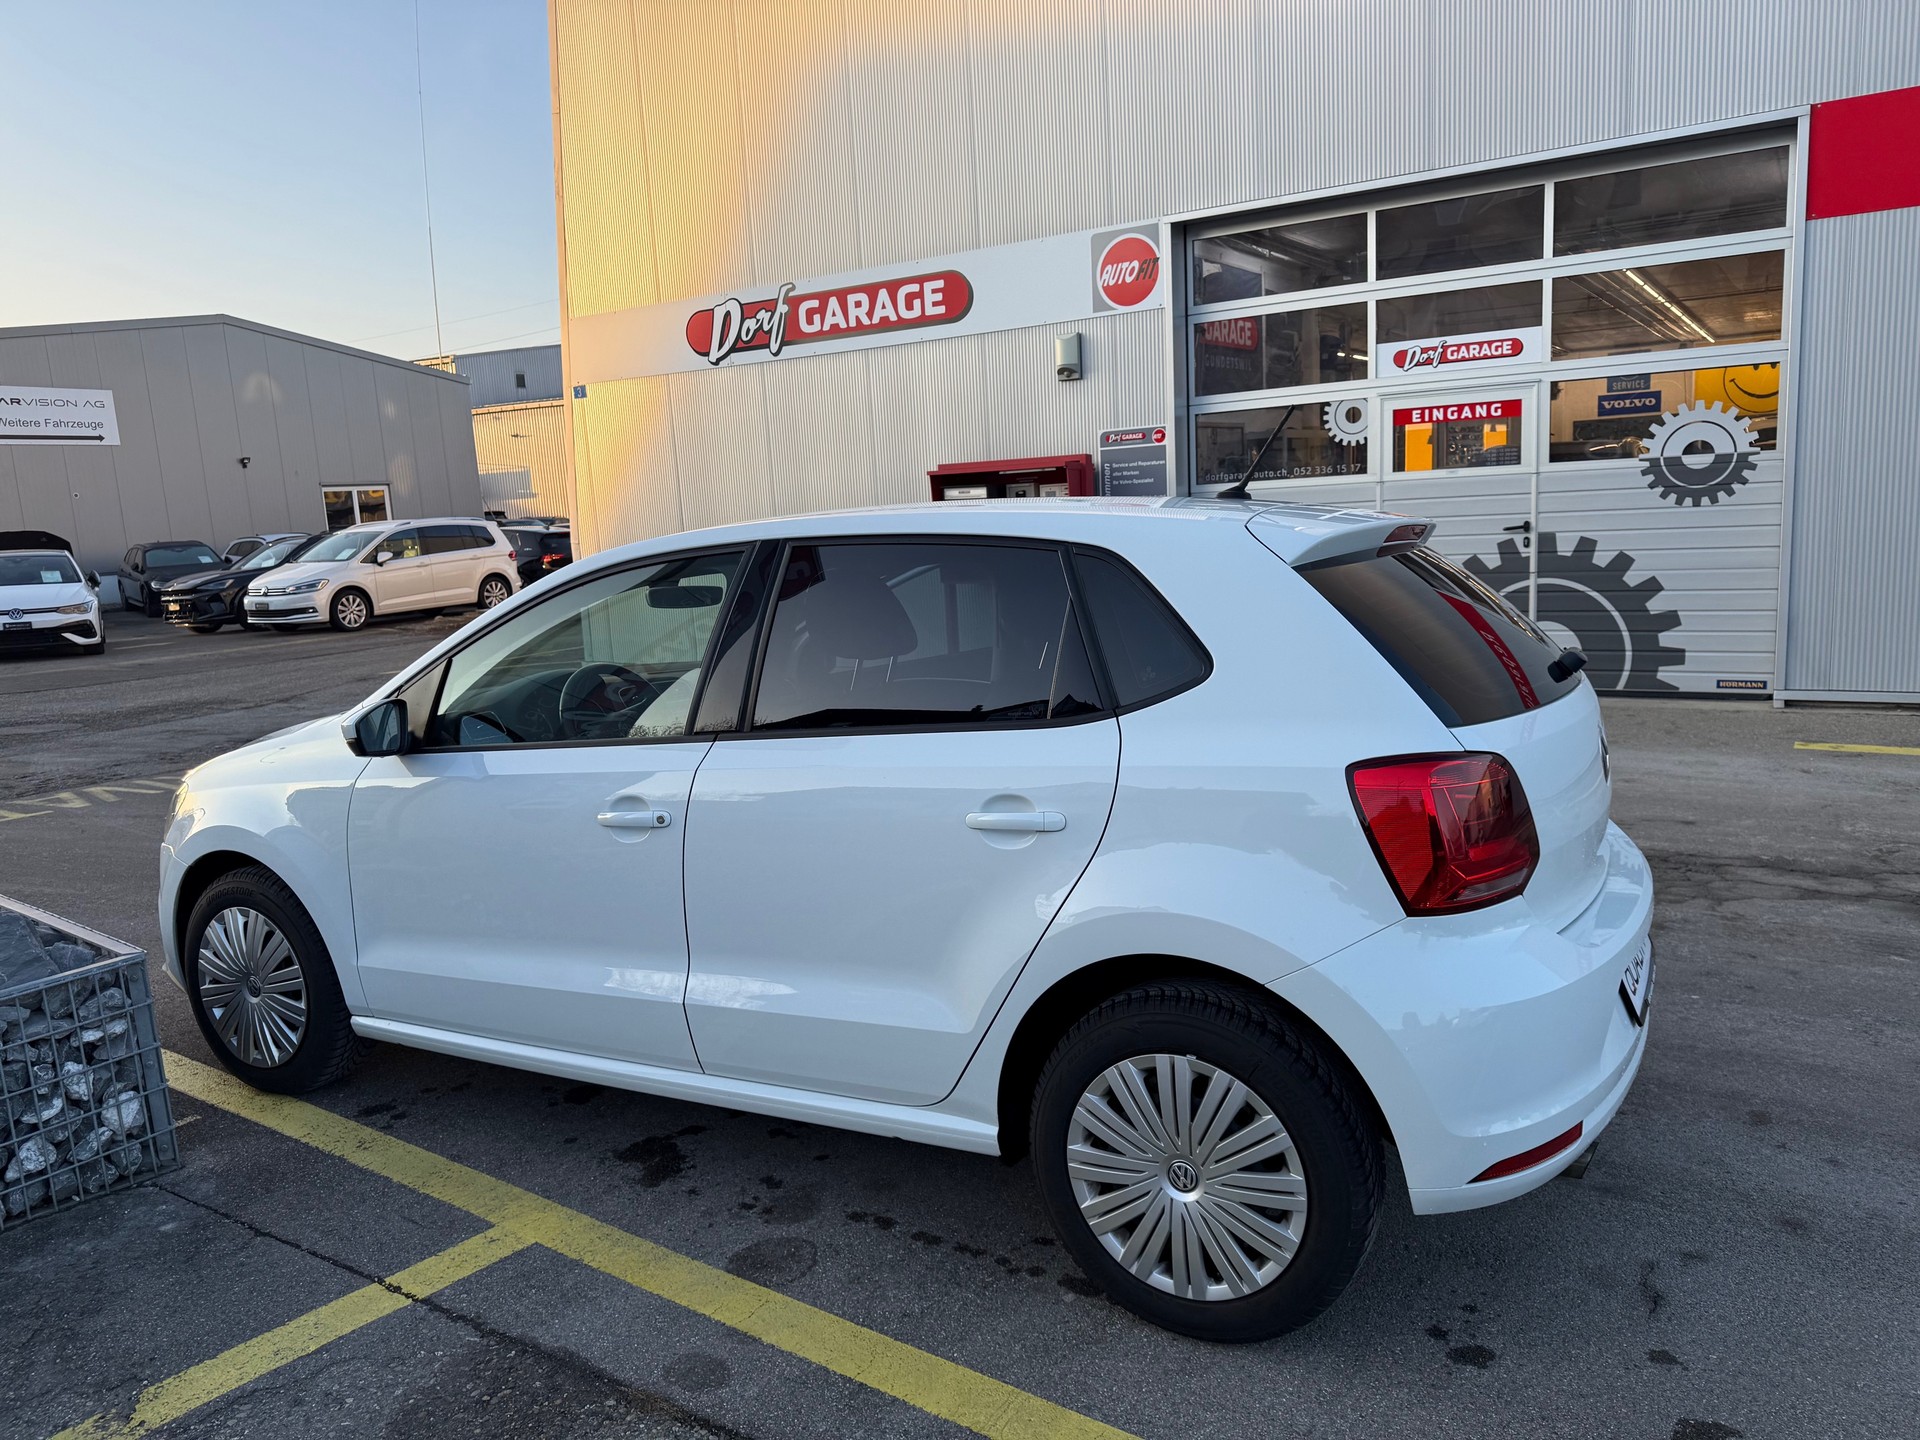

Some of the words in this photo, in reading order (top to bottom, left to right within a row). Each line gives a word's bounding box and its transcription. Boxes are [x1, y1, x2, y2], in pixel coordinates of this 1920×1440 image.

[1101, 257, 1160, 287] AUTOFIT
[708, 283, 795, 365] Dorf
[798, 279, 946, 334] GARAGE
[1402, 340, 1447, 372] Dorf
[1446, 341, 1513, 360] GARAGE
[1612, 380, 1645, 390] SERVICE
[576, 387, 582, 397] 3
[83, 400, 105, 408] AG
[1601, 398, 1656, 409] VOLVO
[1411, 403, 1502, 423] EINGANG
[44, 418, 104, 431] Fahrzeuge
[1121, 432, 1143, 440] GARAGE
[1294, 466, 1312, 476] 052
[1315, 465, 1333, 475] 336
[1336, 464, 1347, 473] 15
[1350, 463, 1361, 472] 17
